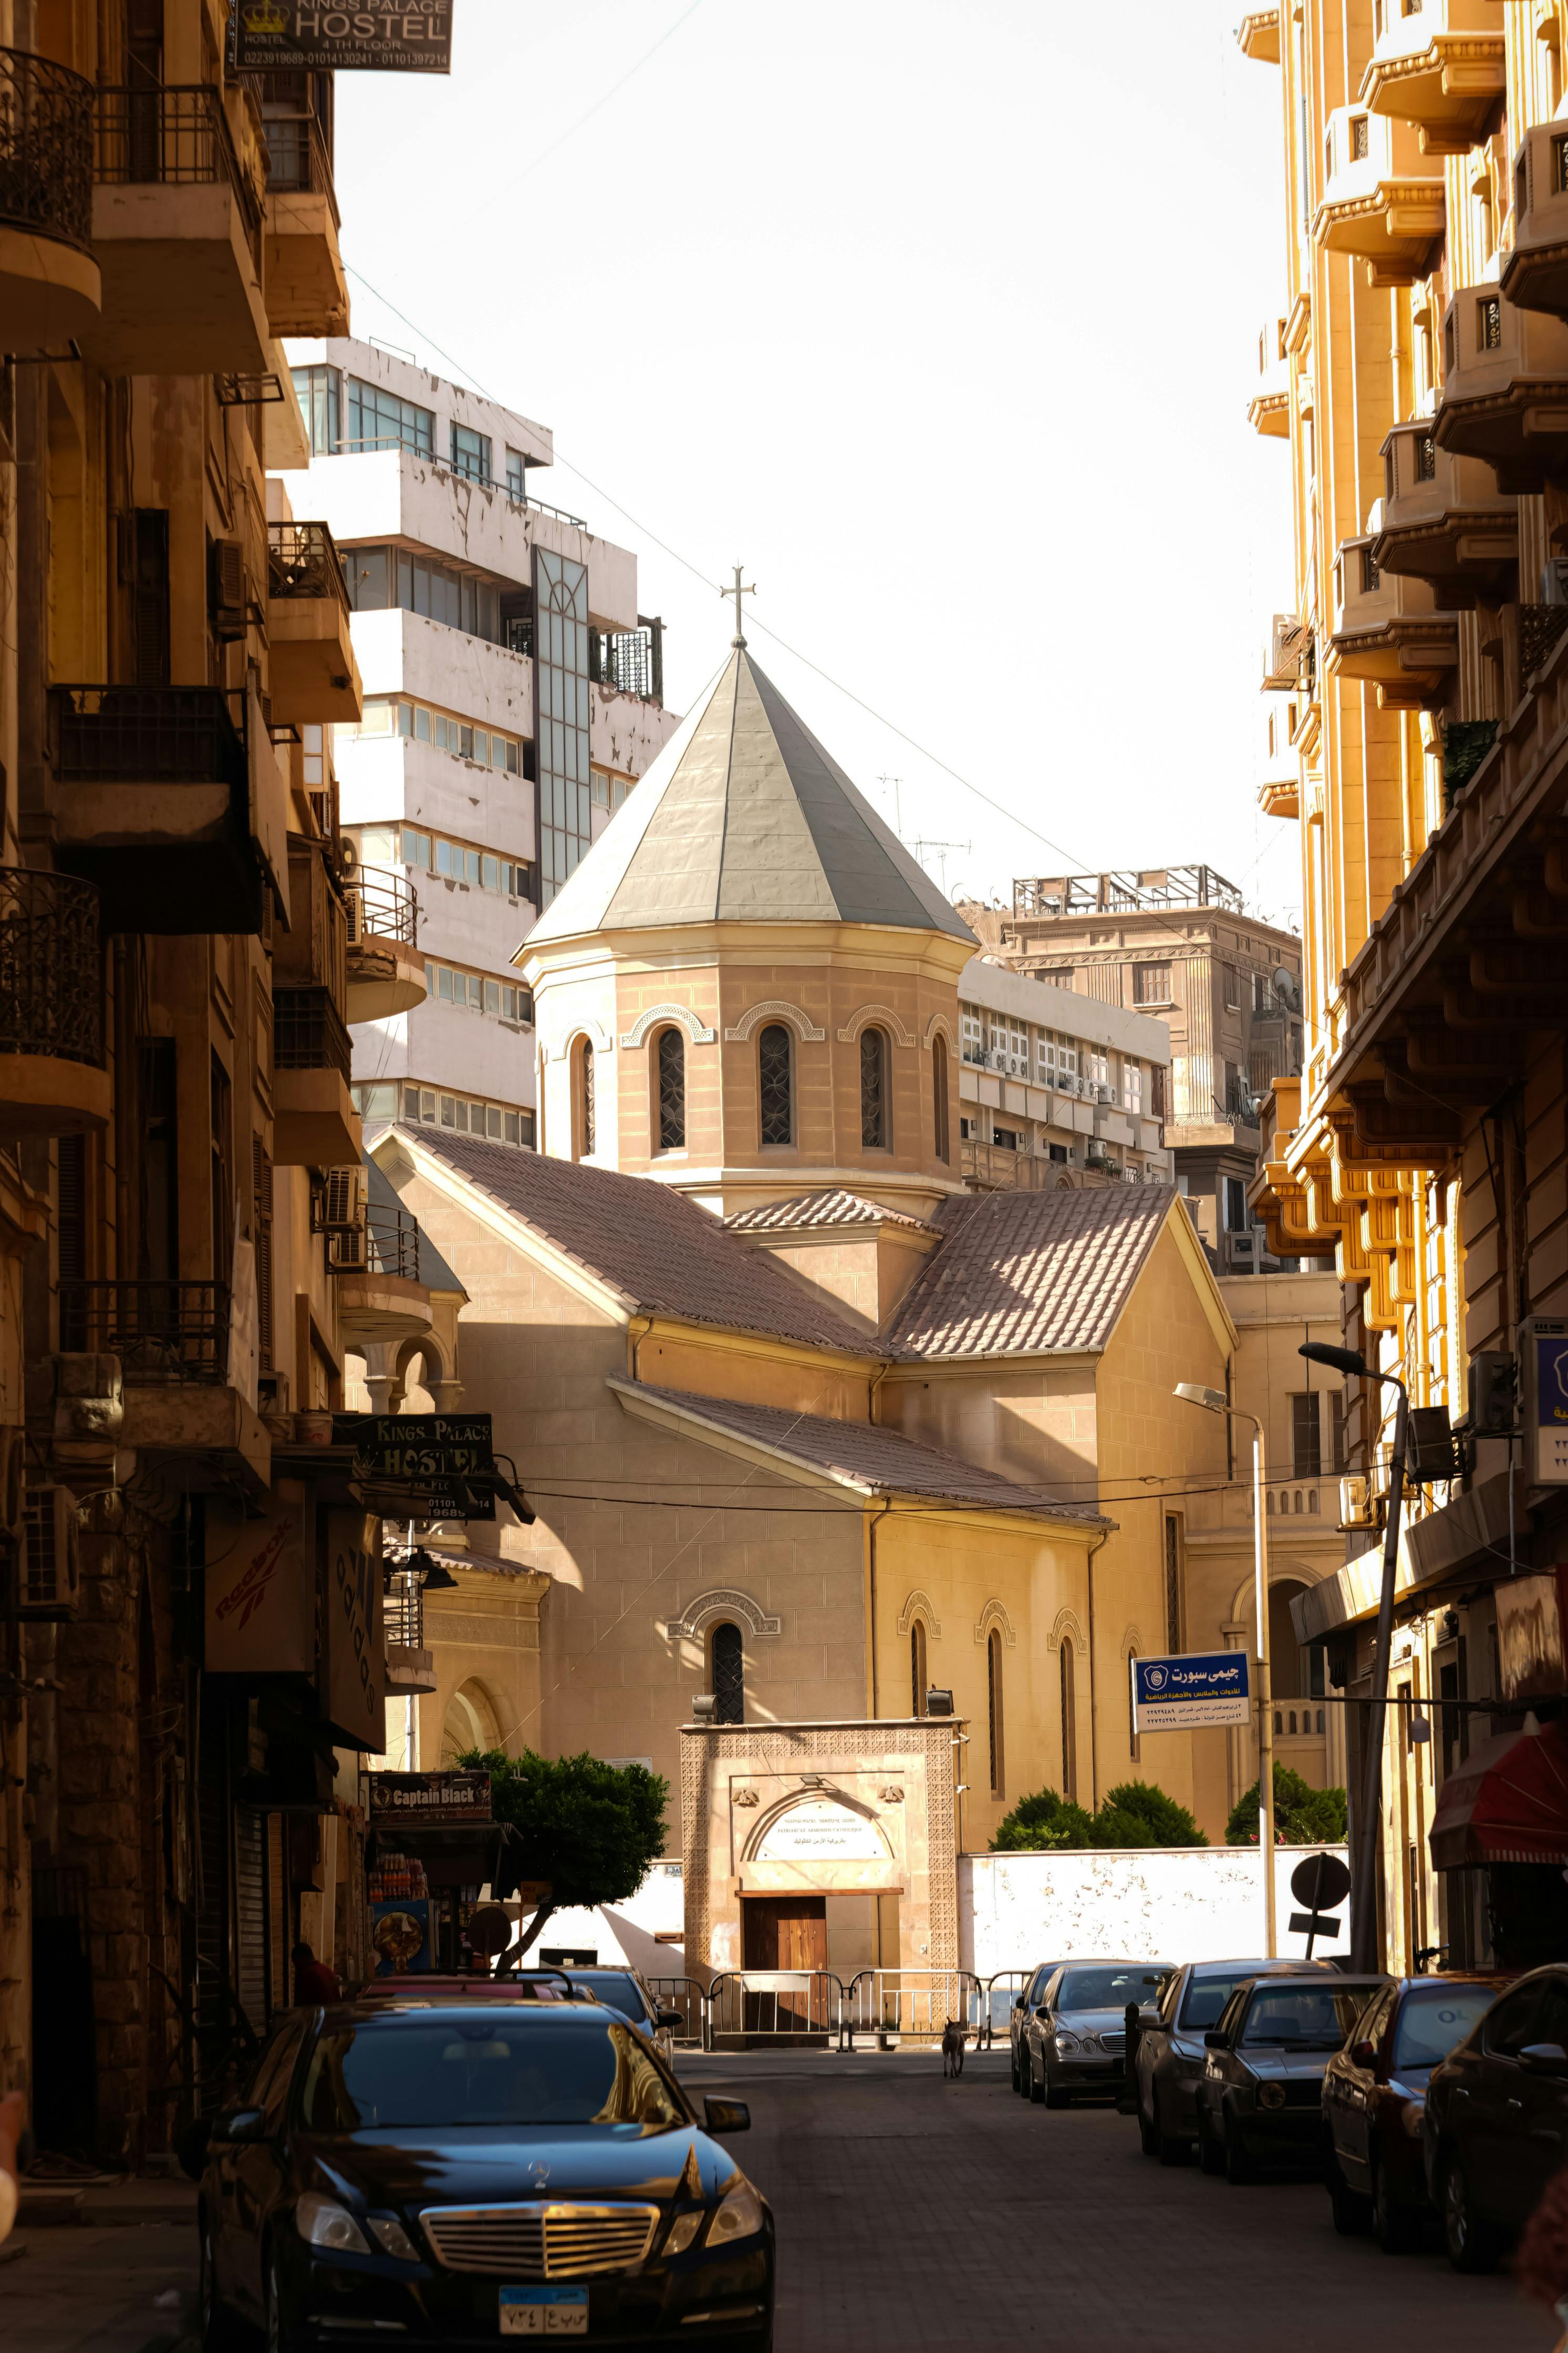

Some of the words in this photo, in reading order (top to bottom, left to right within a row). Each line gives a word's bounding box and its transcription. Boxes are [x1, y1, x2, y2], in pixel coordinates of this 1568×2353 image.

[298, 0, 360, 11] KINGS
[367, 0, 447, 14] PALACE
[296, 12, 446, 40] HOSTEL
[245, 34, 285, 45] HOSTEL
[322, 40, 329, 49] 4
[336, 40, 351, 50] TH
[356, 40, 401, 50] FLOOR
[215, 1517, 294, 1621] Reebok
[337, 1554, 376, 1716] adidas
[1171, 1668, 1207, 1684] سبورت
[1168, 1691, 1191, 1699] والأجهزة
[393, 1788, 440, 1807] Captain
[441, 1786, 475, 1804] Black
